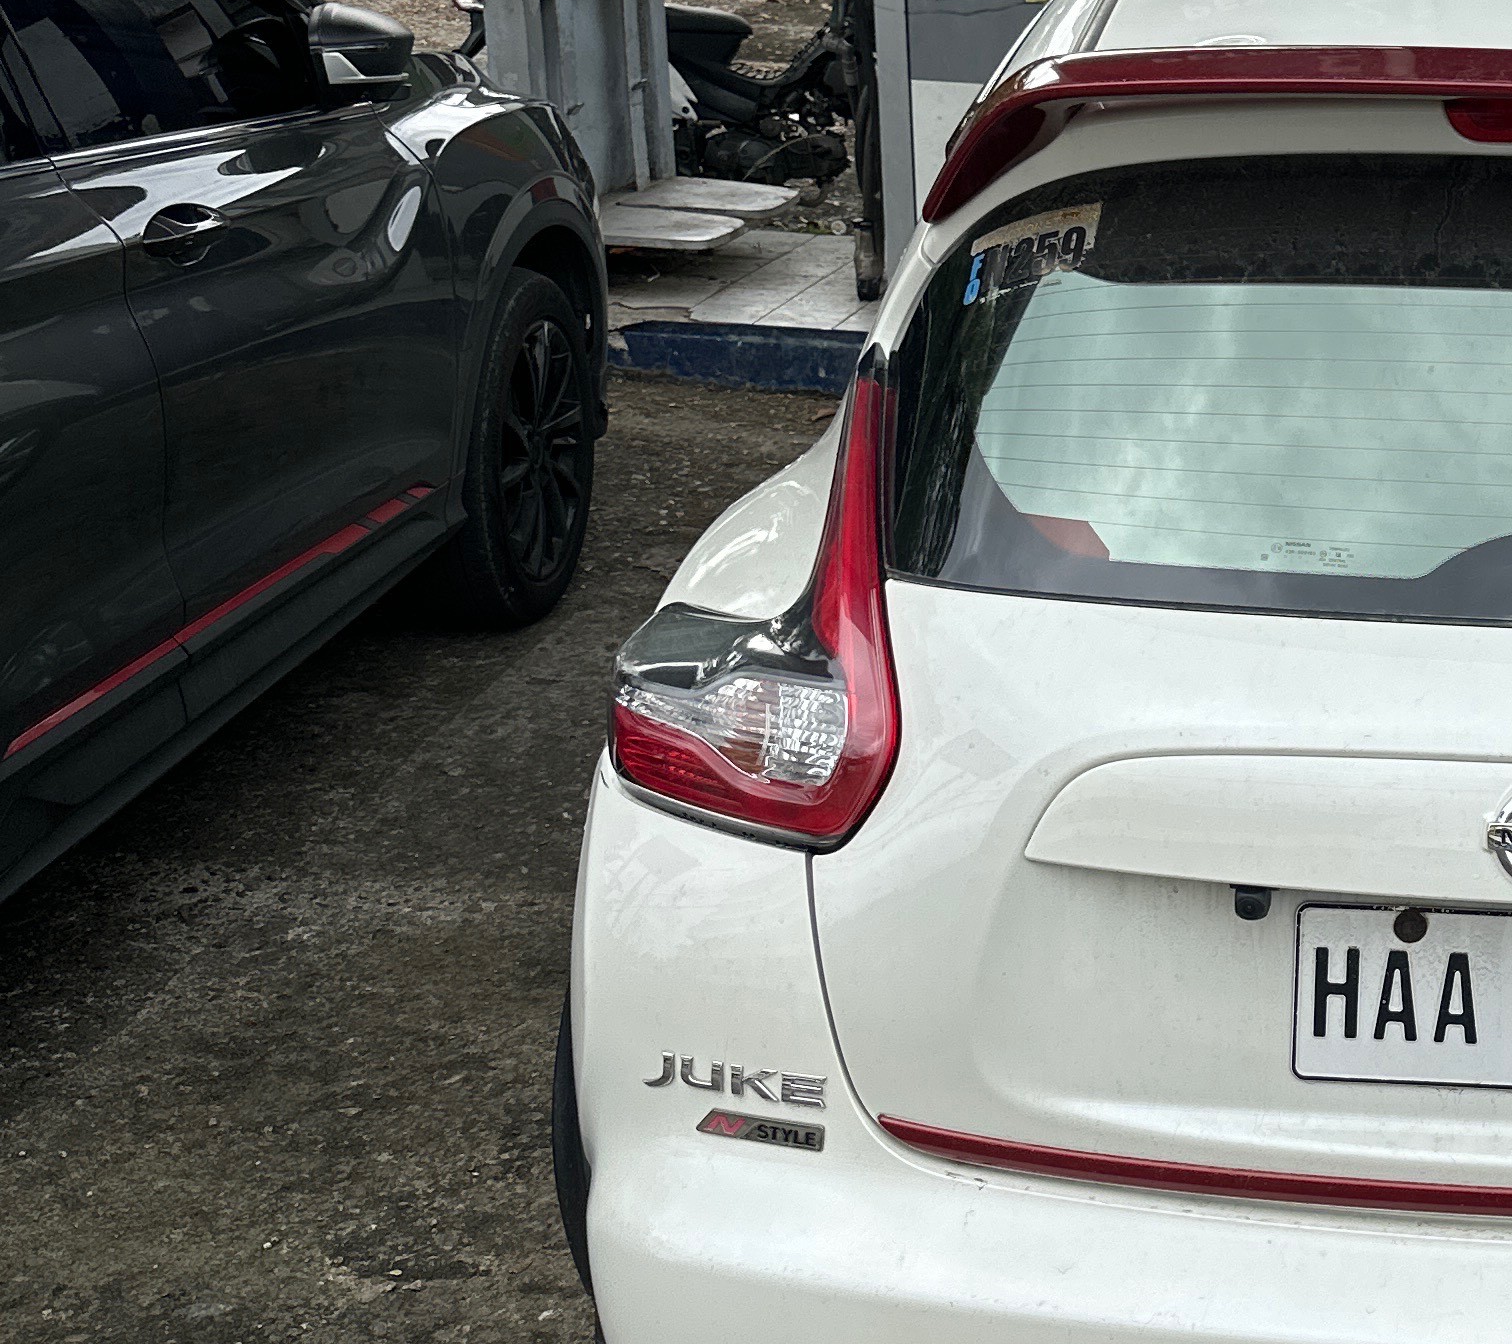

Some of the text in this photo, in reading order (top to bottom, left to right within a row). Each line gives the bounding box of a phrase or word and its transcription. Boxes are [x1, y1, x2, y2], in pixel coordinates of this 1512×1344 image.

[1313, 945, 1478, 1045] HAA
[642, 1050, 828, 1108] JUKE
[756, 1123, 817, 1148] STYLE
